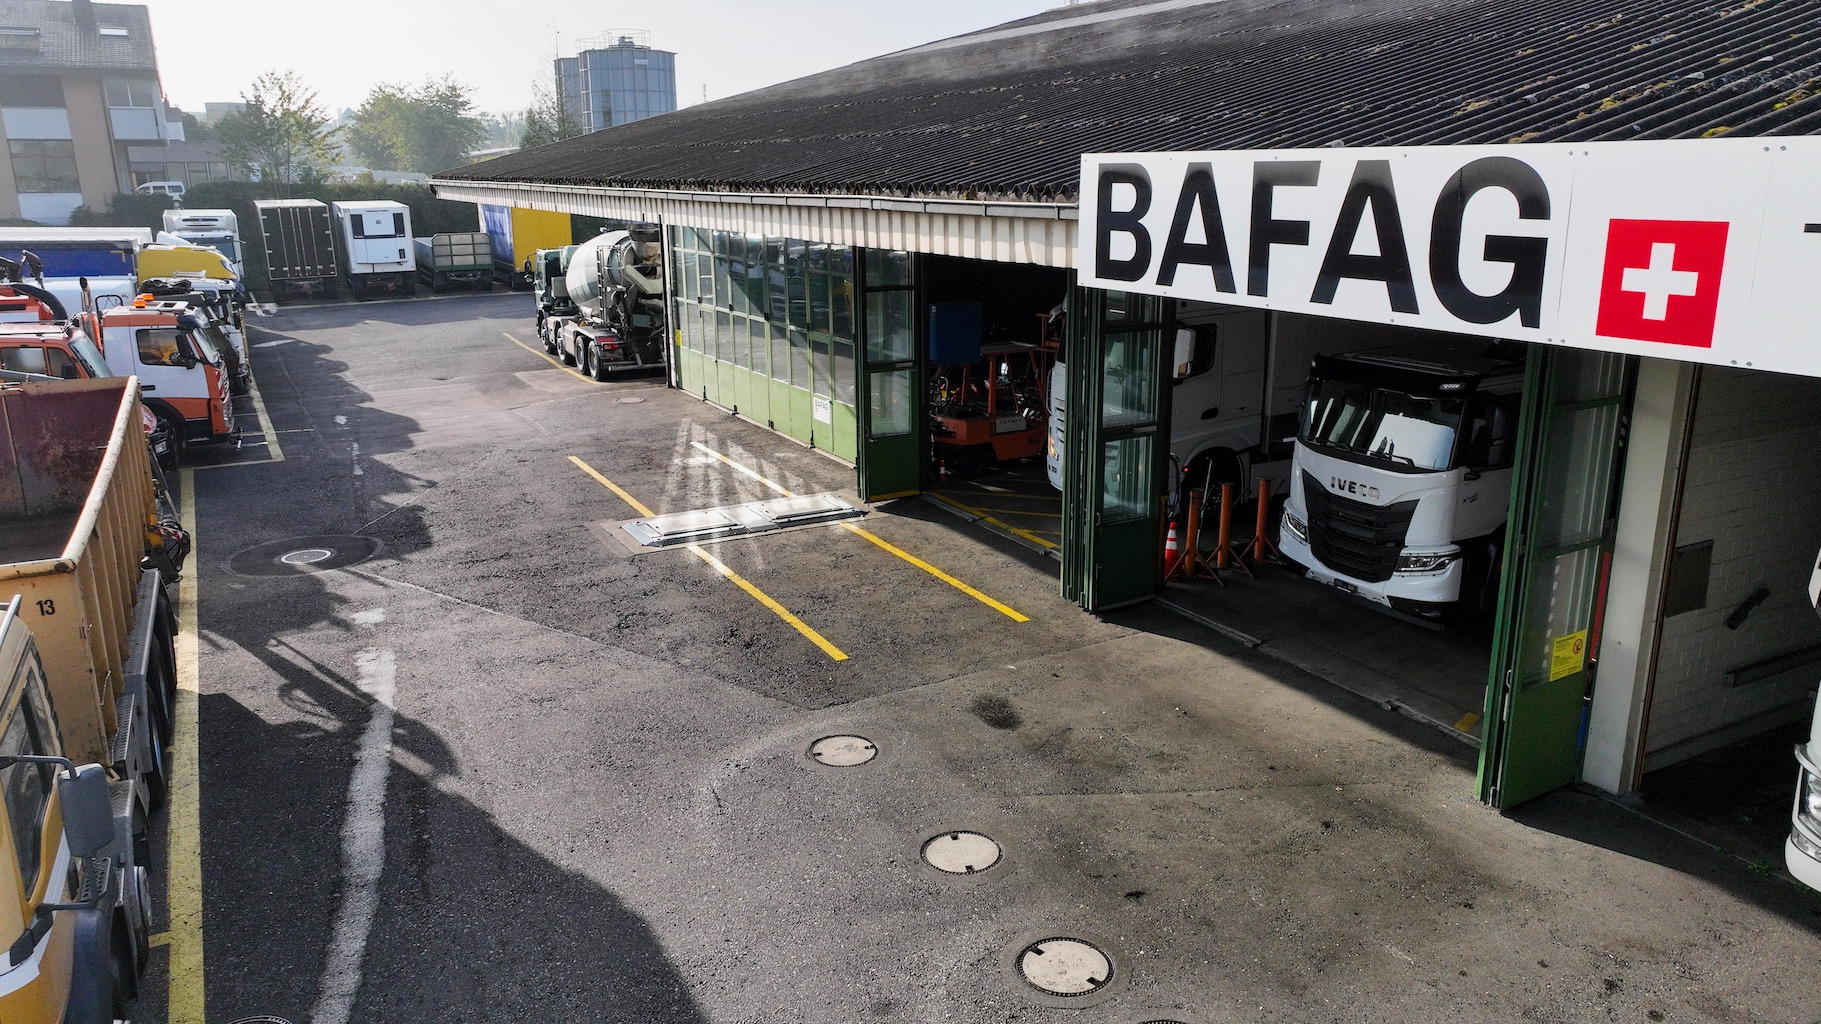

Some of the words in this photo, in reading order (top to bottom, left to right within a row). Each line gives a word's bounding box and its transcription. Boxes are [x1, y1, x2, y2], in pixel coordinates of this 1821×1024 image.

[1095, 156, 1551, 329] BAFAG
[1331, 476, 1380, 500] IVECO
[36, 599, 56, 616] 13
